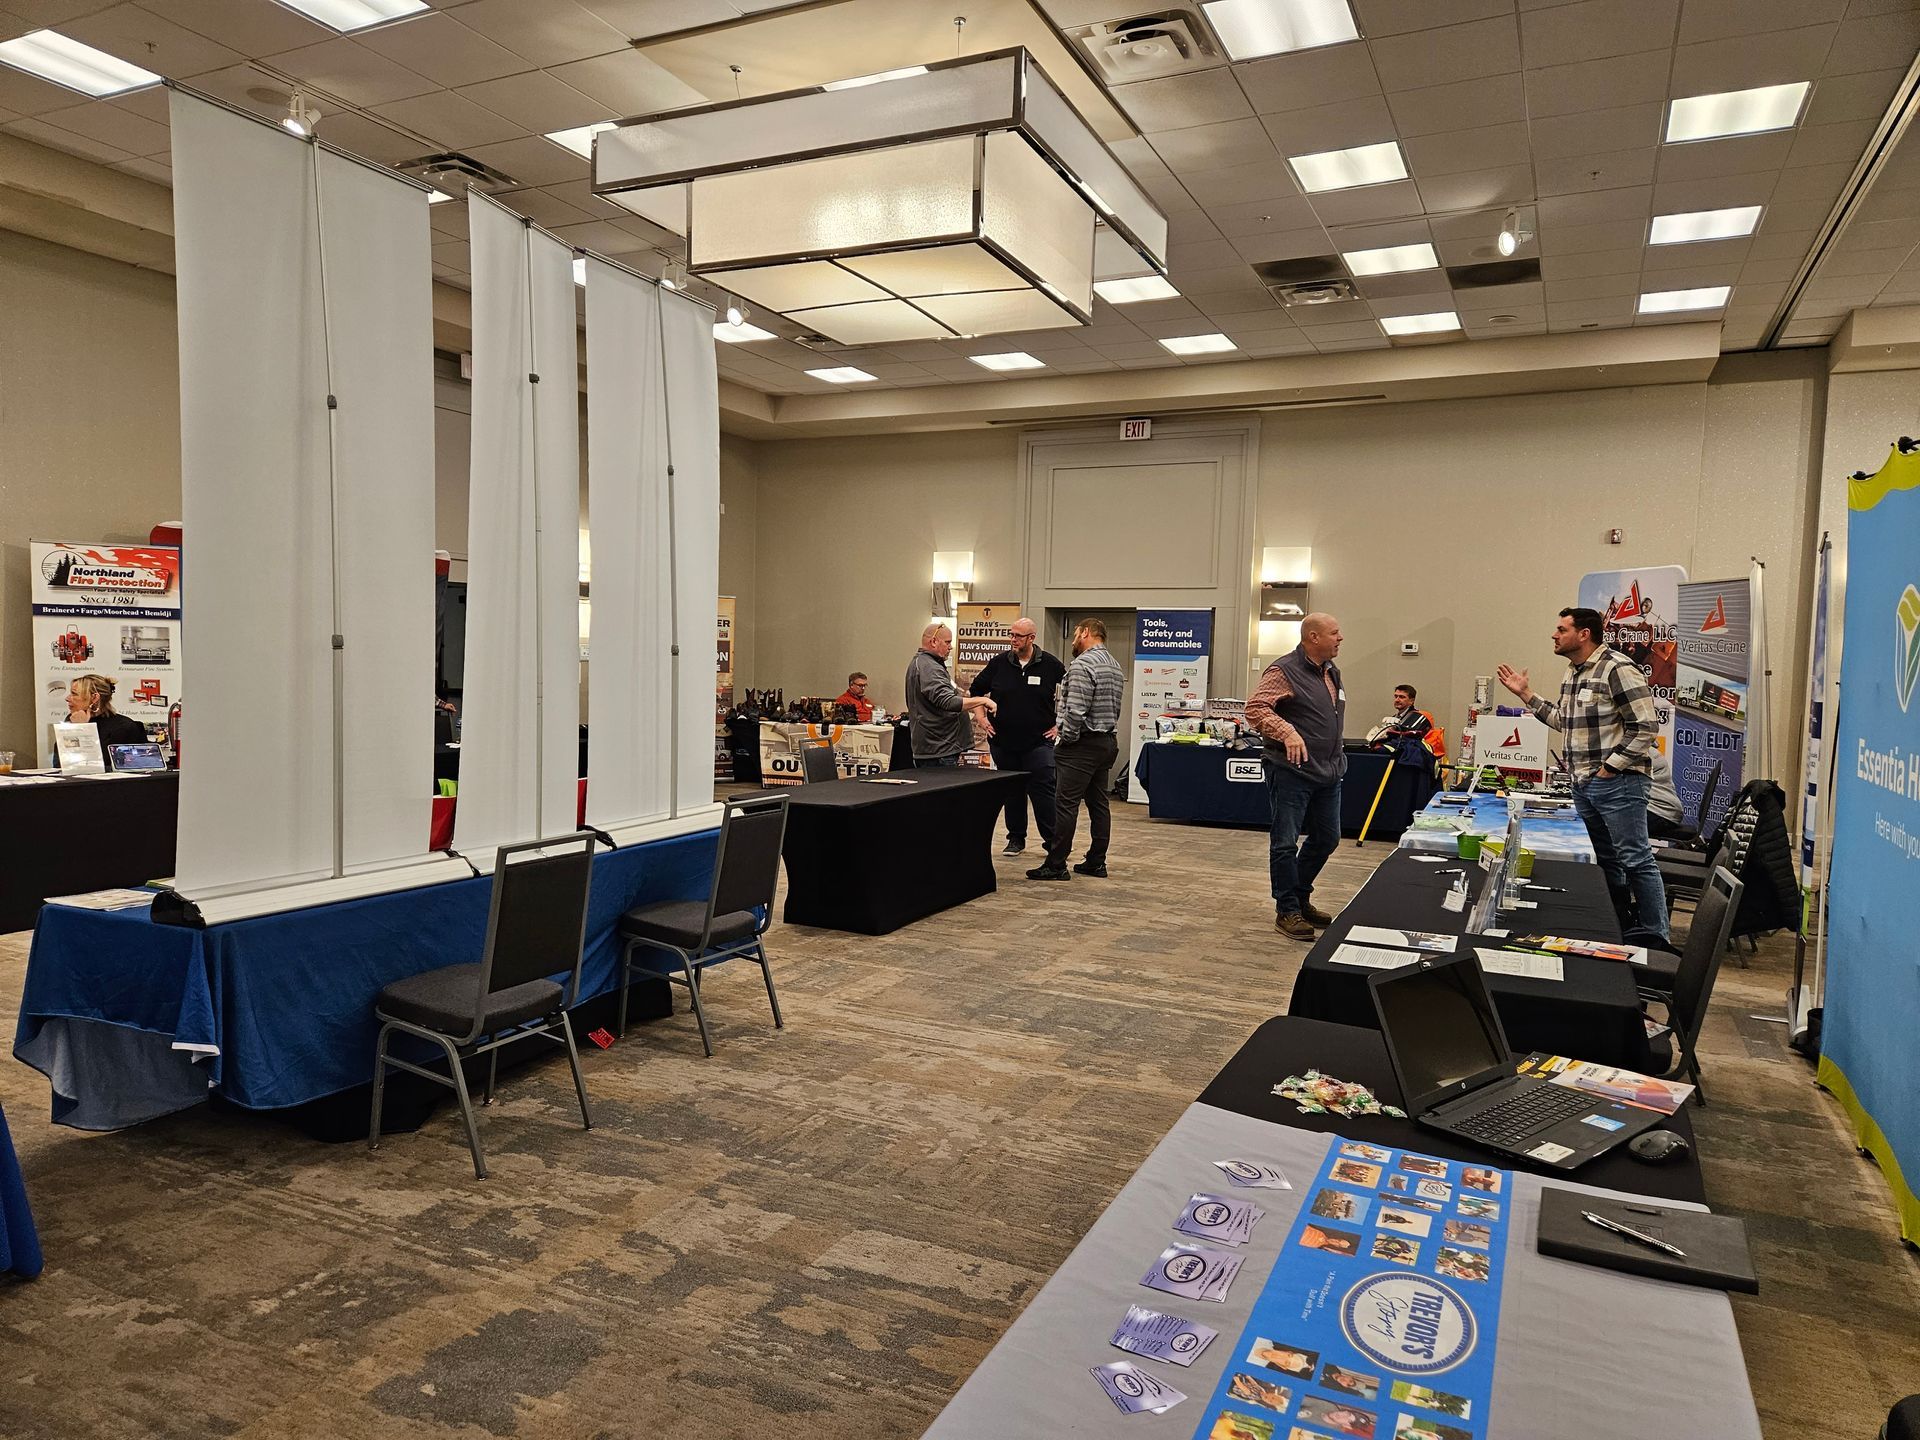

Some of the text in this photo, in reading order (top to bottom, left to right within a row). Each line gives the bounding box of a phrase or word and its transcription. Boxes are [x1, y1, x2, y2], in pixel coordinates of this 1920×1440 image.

[1125, 421, 1146, 438] EXIT
[73, 567, 135, 578] Northland
[69, 576, 161, 588] Fire Protection
[112, 596, 136, 605] 1981
[42, 606, 75, 614] Brainerd
[80, 608, 139, 616] Fargo/Moorhead
[1142, 618, 1168, 628] Tools,
[1142, 629, 1193, 640] Safety and
[1617, 627, 1650, 643] Crane
[1652, 626, 1677, 642] LLC
[1142, 639, 1202, 649] Consumables
[1681, 639, 1747, 653] Veritas Crane
[959, 652, 999, 661] ADVANT
[1484, 750, 1538, 763] Veritas Crane
[1235, 766, 1258, 774] BSE
[1857, 738, 1905, 796] Essentia
[1907, 753, 1920, 802] H
[1875, 811, 1891, 840] Here
[1891, 821, 1906, 850] with
[1401, 1291, 1444, 1360] TREVOR'S
